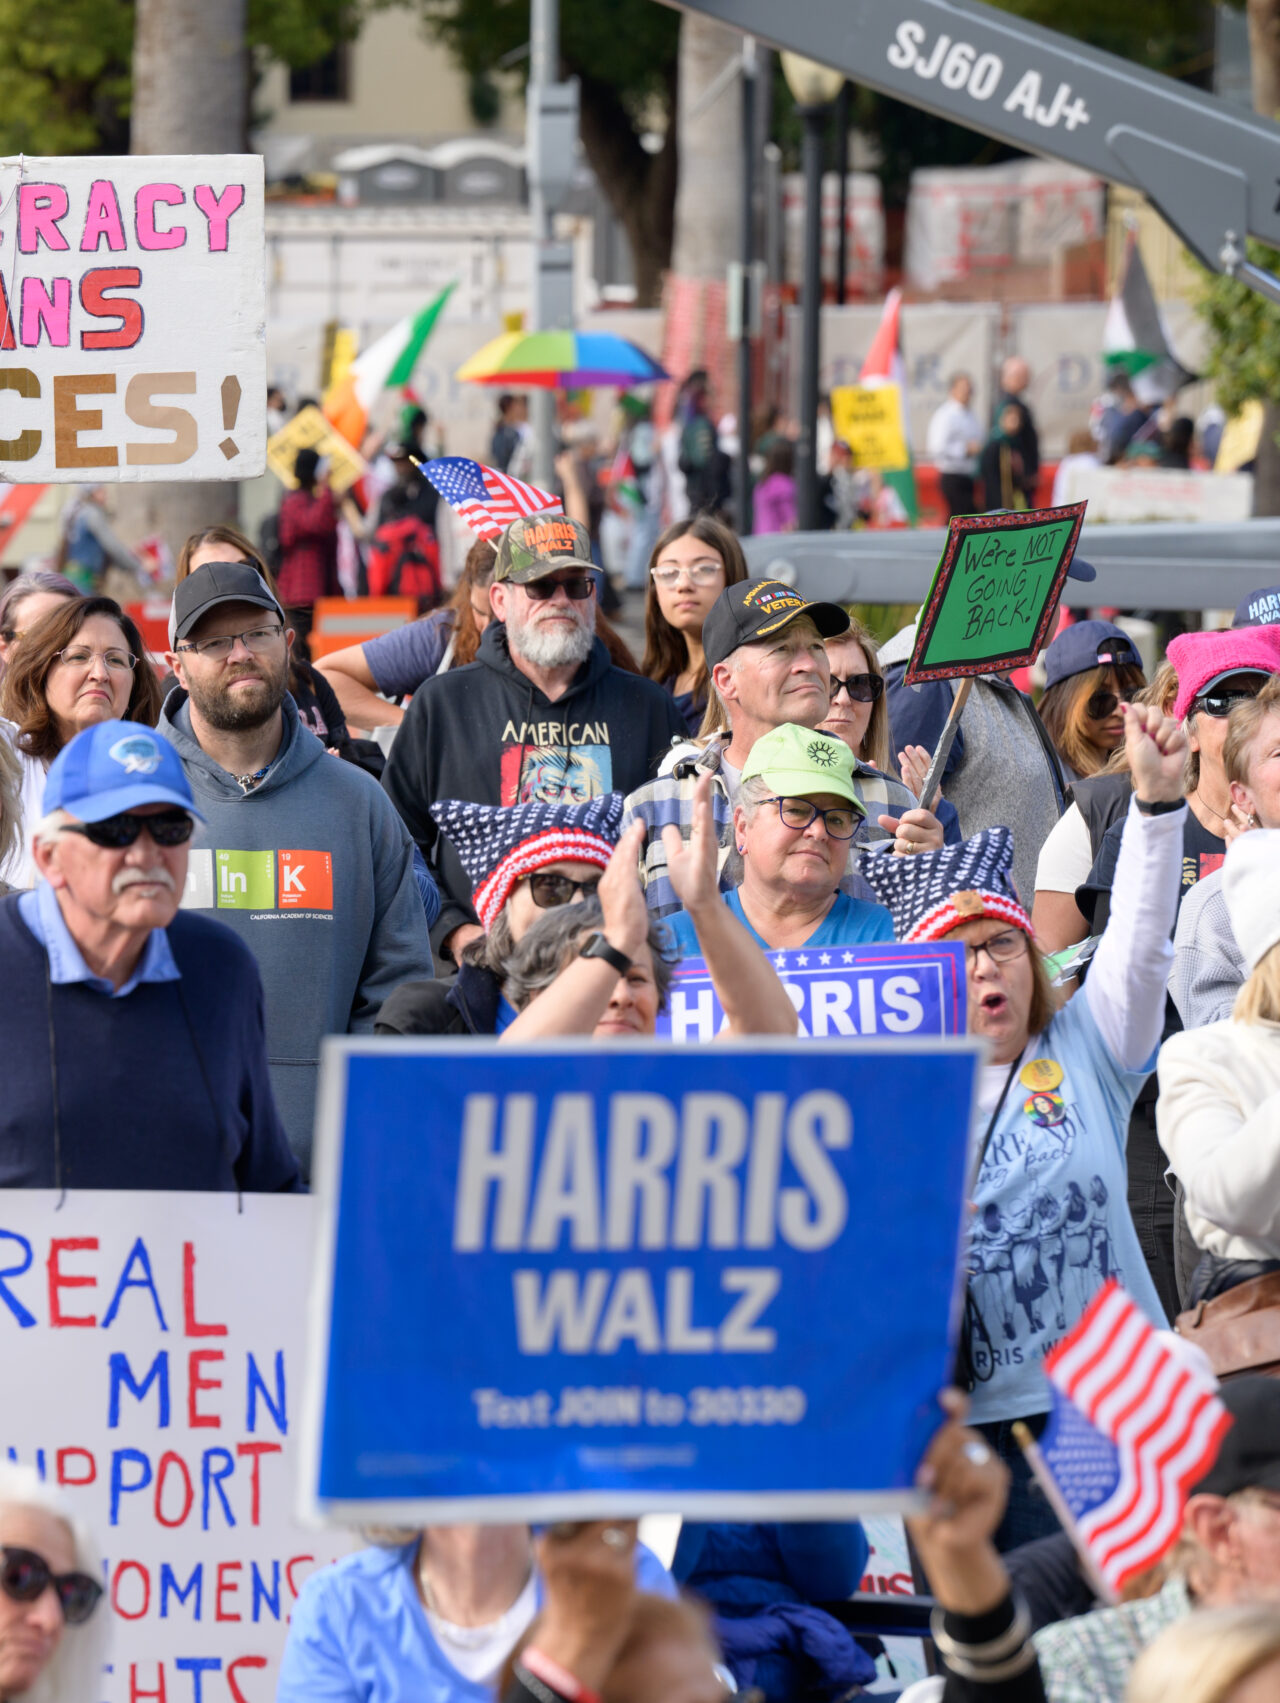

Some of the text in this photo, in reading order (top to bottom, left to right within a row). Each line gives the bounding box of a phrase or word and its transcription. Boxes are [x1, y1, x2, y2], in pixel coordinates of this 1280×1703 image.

[887, 20, 1090, 131] SJ60 AJ+
[523, 521, 578, 548] HARRIS
[536, 540, 574, 555] WALZ
[1023, 528, 1064, 561] NOT
[966, 569, 1027, 604] GOING
[961, 574, 1042, 640] BACK!
[501, 720, 611, 746] AMERICAN
[283, 865, 307, 892] K
[1182, 856, 1197, 885] 2017
[453, 1090, 854, 1253] HARRIS
[513, 1267, 781, 1355] WALZ
[108, 1350, 287, 1435] MEN
[472, 1385, 807, 1430] Text JOIN to 30330
